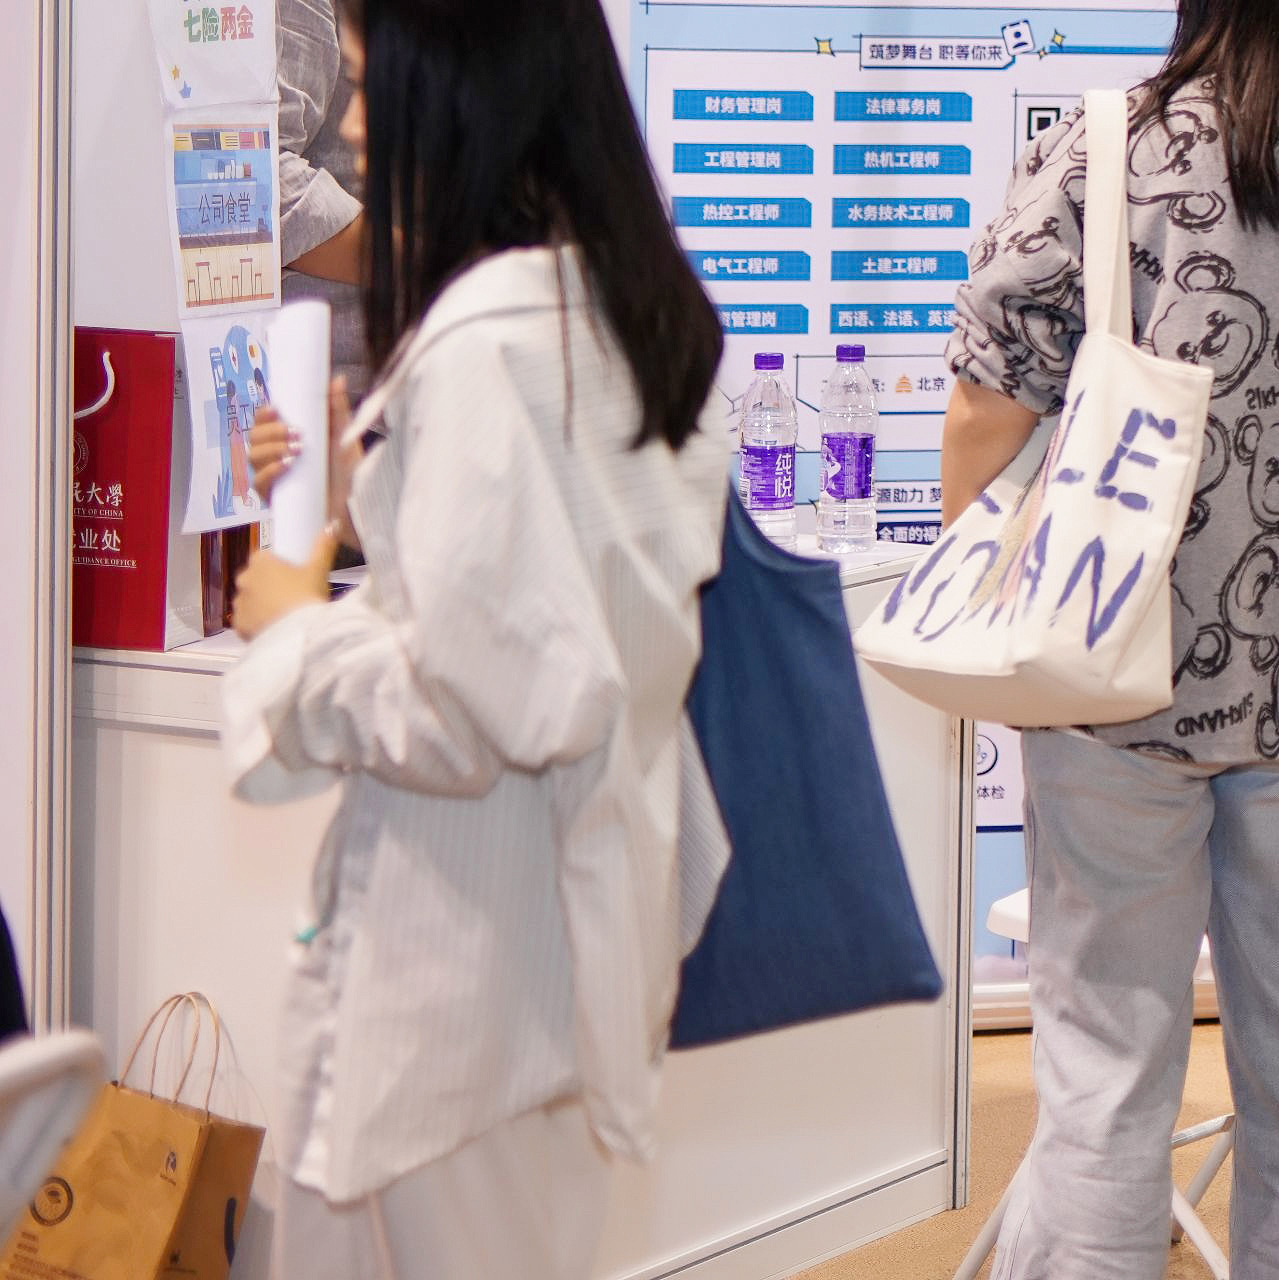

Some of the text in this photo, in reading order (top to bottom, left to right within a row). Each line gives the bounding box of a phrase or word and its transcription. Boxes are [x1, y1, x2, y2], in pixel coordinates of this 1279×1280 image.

[183, 4, 255, 43] 七险两金
[869, 44, 1003, 62] 筑梦舞台 职等你来
[705, 97, 781, 114] 财务管理岗
[866, 98, 941, 116] 法律事务岗
[704, 152, 781, 169] 工程管理岗
[864, 151, 939, 169] 热机工程师
[198, 191, 252, 225] 公司食堂
[703, 204, 780, 221] 热控工程师
[848, 204, 953, 221] 水务技术工程师
[703, 257, 779, 274] 电气工程师
[863, 257, 938, 274] 土建工程师
[917, 377, 946, 392] 北京
[227, 402, 261, 437] 员工
[774, 453, 793, 499] 纯悦
[99, 509, 124, 518] CHINA
[73, 527, 121, 552] 业处
[879, 526, 941, 543] 全面的福
